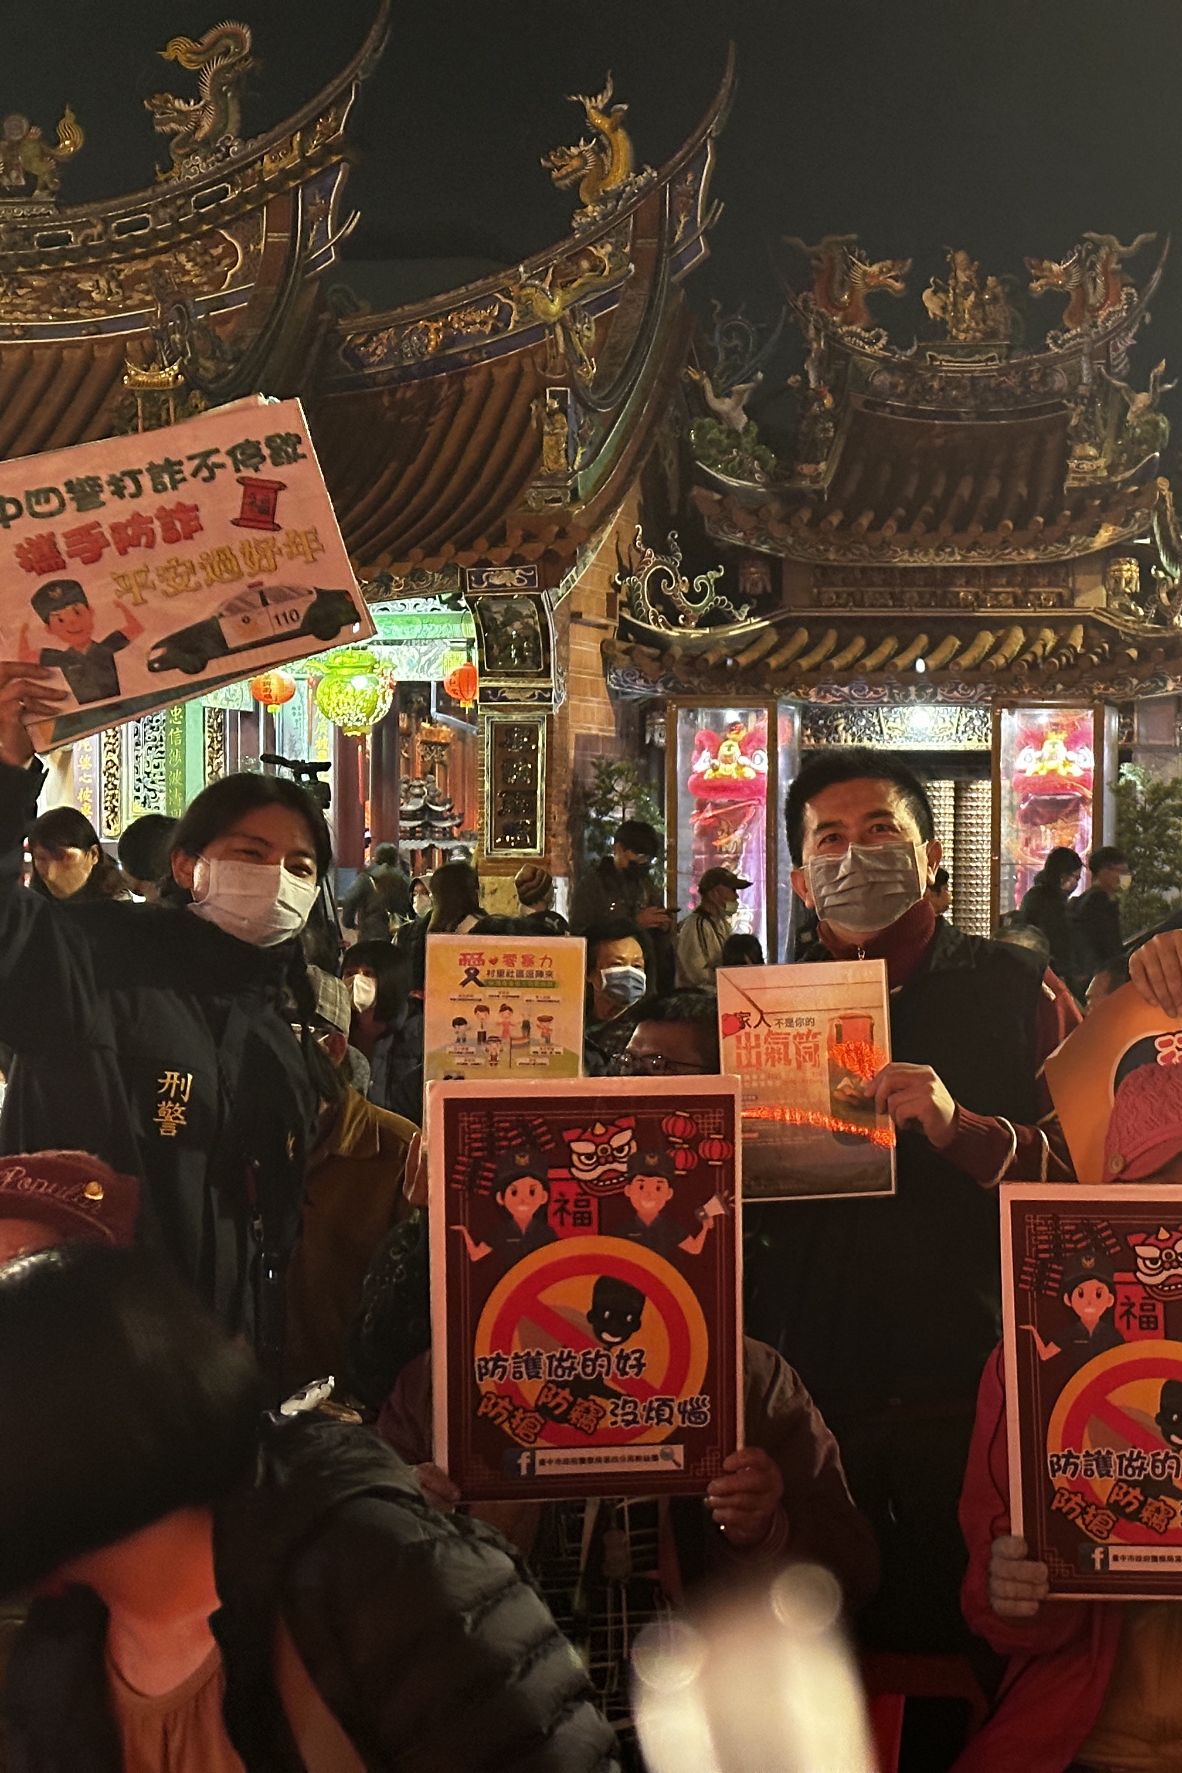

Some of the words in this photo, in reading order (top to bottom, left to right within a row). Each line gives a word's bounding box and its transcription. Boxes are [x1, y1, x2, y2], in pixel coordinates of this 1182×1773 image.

[14, 502, 204, 576] 攜手防詐
[110, 525, 325, 607] 平安過好年
[273, 610, 300, 628] 110
[774, 1017, 816, 1029] 不是你的
[735, 1029, 822, 1071] 出氣筒
[153, 1071, 193, 1136] 刑警
[553, 1194, 592, 1229] 福
[1120, 1296, 1159, 1330] 福
[475, 1348, 647, 1384] 防護做的好
[607, 1395, 711, 1428] 沒煩惱
